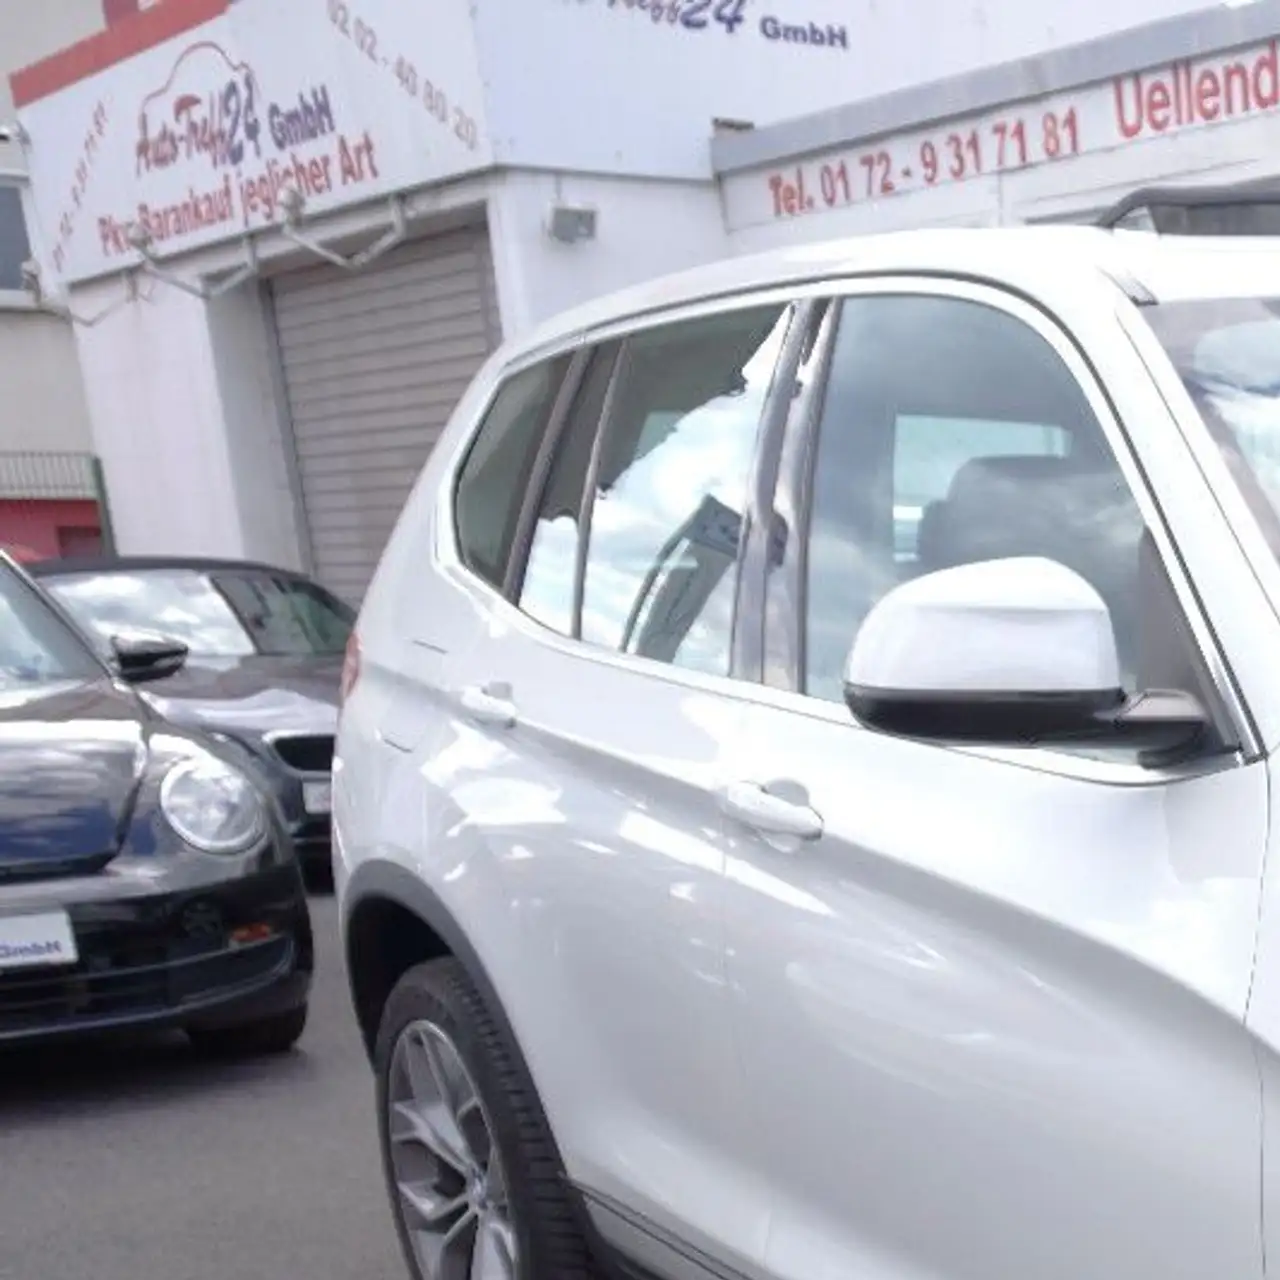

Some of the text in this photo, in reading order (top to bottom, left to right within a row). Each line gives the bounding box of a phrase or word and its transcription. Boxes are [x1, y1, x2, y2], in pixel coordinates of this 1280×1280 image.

[760, 16, 848, 48] GmbH
[268, 85, 336, 150] GmbH
[338, 130, 379, 186] Art
[768, 166, 814, 217] Tel.
[820, 160, 851, 207] 01
[860, 151, 896, 196] 72
[920, 140, 937, 184] 9
[945, 129, 981, 181] 31
[993, 118, 1027, 168] 71
[1042, 106, 1079, 157] 81
